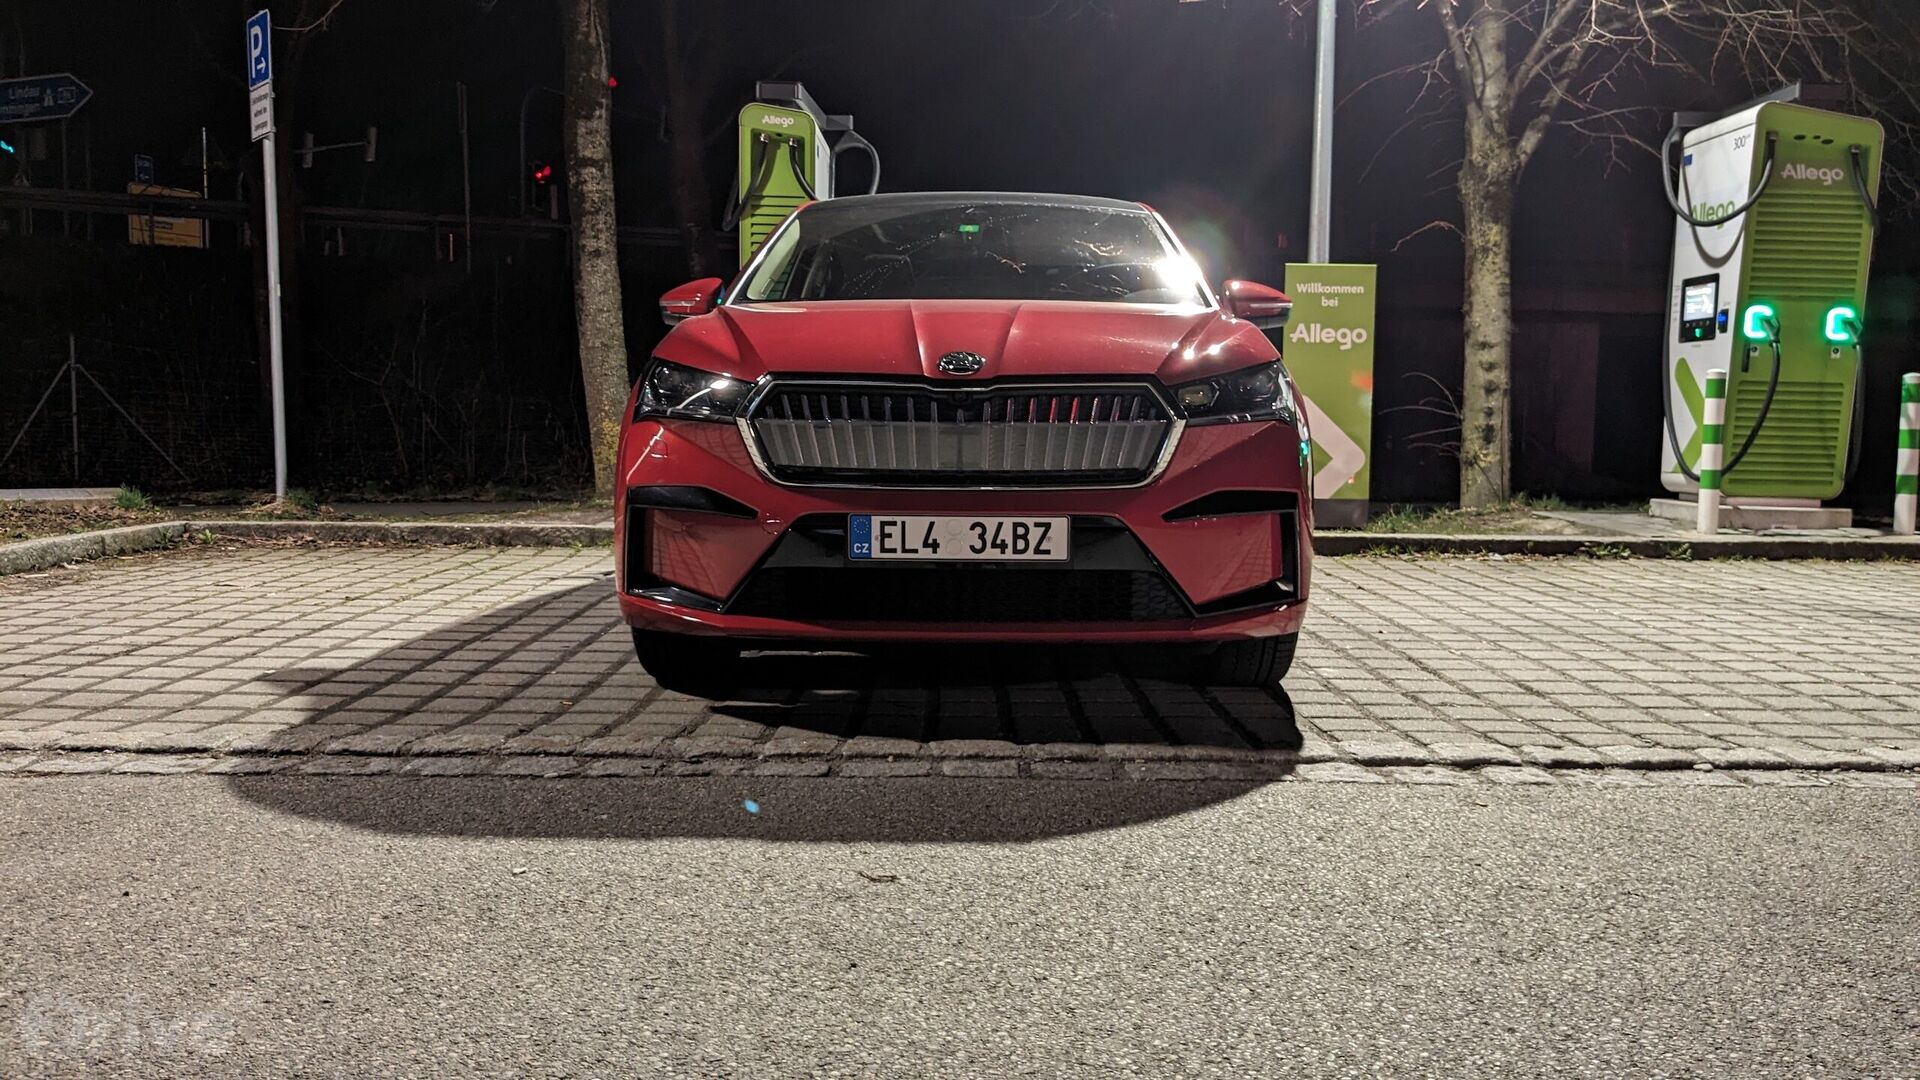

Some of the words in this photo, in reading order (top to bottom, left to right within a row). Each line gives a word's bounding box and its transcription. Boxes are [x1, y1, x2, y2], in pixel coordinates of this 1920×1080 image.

[249, 24, 263, 79] P
[761, 114, 795, 128] Allego
[1780, 163, 1844, 186] Allego
[1296, 282, 1365, 294] Willkommen
[1321, 295, 1339, 307] bei
[1289, 322, 1368, 351] Allego
[879, 520, 941, 555] EL4
[968, 521, 1053, 556] 34BZ
[853, 542, 870, 554] CZ
